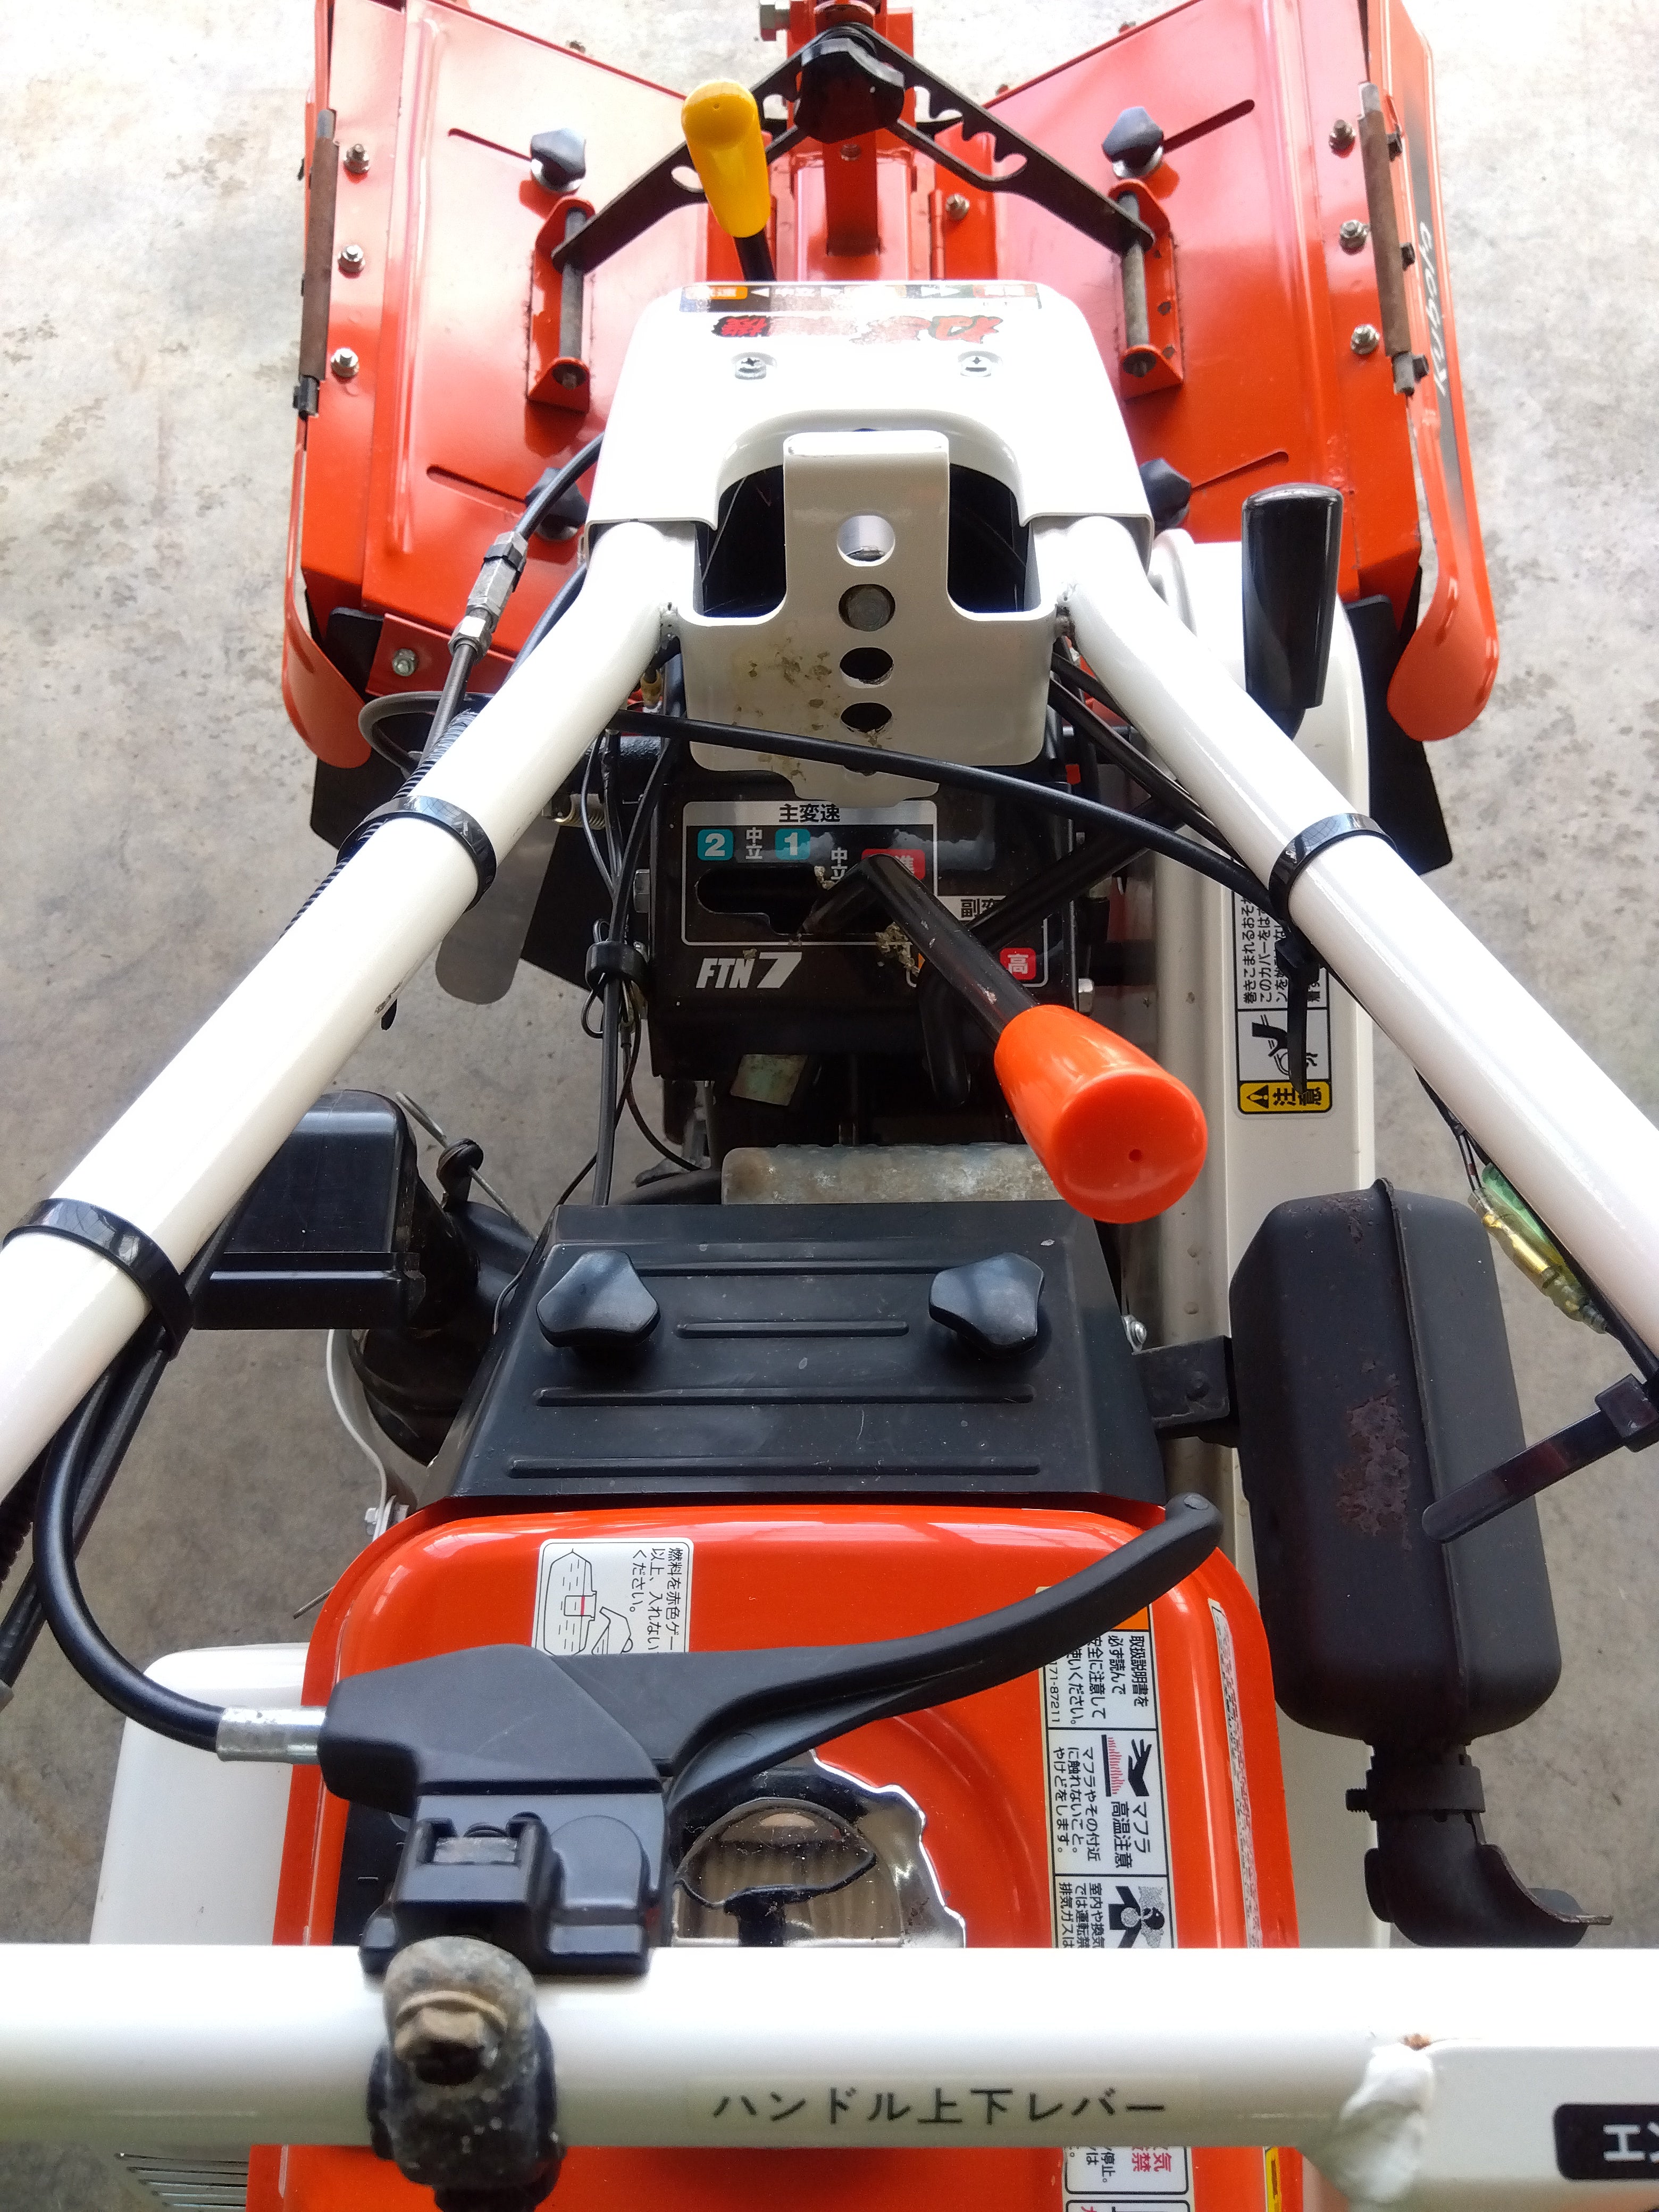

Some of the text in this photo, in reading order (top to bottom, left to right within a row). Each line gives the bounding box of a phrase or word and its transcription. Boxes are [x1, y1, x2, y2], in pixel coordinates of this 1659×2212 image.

[780, 803, 840, 823] 主変速
[704, 833, 726, 857] 2
[745, 827, 763, 860] 中立
[784, 832, 798, 856] 1
[831, 847, 848, 879] 中立
[1008, 954, 1029, 974] 高
[630, 1549, 647, 1612] ください。
[666, 1547, 683, 1650] 燃料を赤色ゲー
[1108, 1636, 1126, 1695] 必ず読んで
[1129, 1635, 1149, 1707] 取扱説明書を
[1053, 1747, 1070, 1854] やけどをします。
[1067, 1747, 1084, 1854] に触れないこと。
[1083, 1746, 1101, 1862] マフラやその付近
[1110, 1800, 1133, 1868] 高温注意
[1132, 1800, 1152, 1853] マフラ
[714, 2085, 1166, 2125] ハンドル上下レバー
[1101, 2147, 1116, 2183] 停止。
[1153, 2147, 1172, 2172] 気
